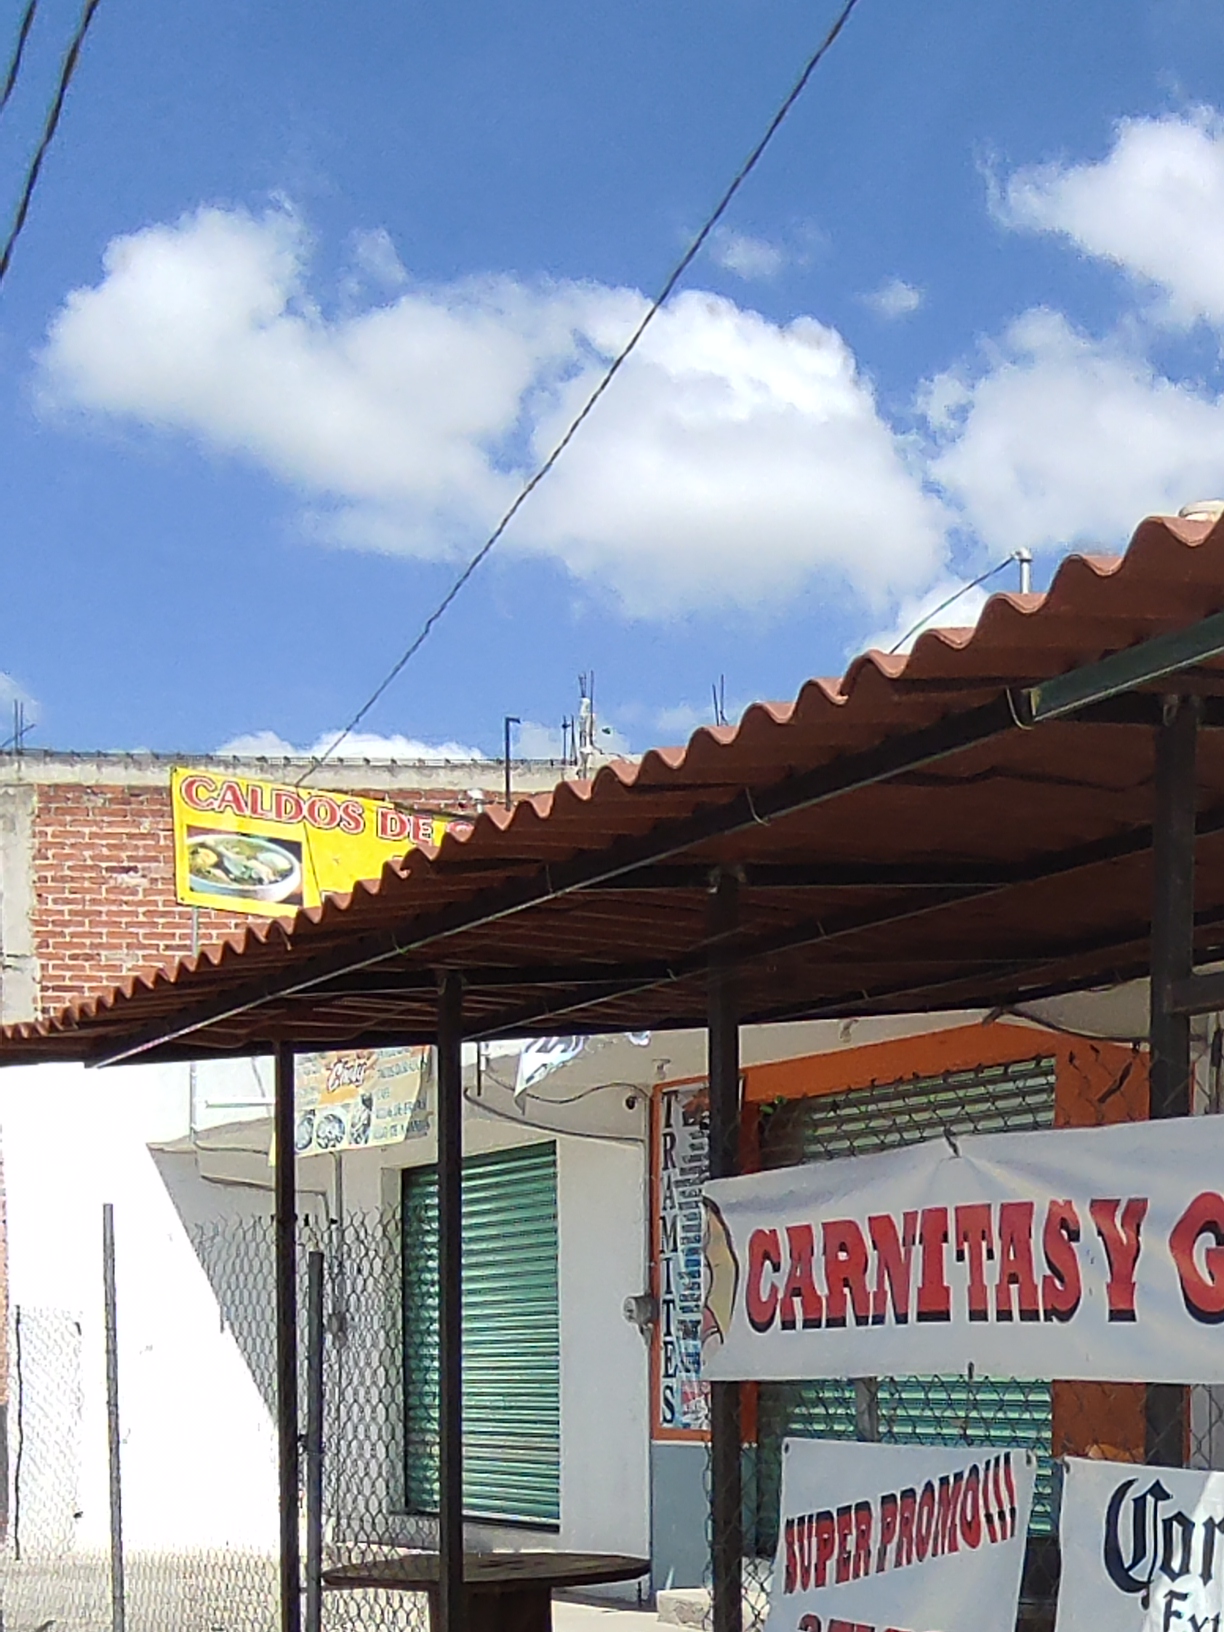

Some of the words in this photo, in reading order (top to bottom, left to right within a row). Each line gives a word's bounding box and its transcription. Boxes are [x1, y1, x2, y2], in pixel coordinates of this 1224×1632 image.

[180, 776, 365, 834] CALDOS
[377, 805, 434, 847] DE
[660, 1090, 678, 1424] TRAMITES
[745, 1200, 1080, 1332] CARNITAS
[1090, 1198, 1149, 1323] Y
[783, 1501, 873, 1594] SUPER
[876, 1451, 1017, 1573] PROMO!!!
